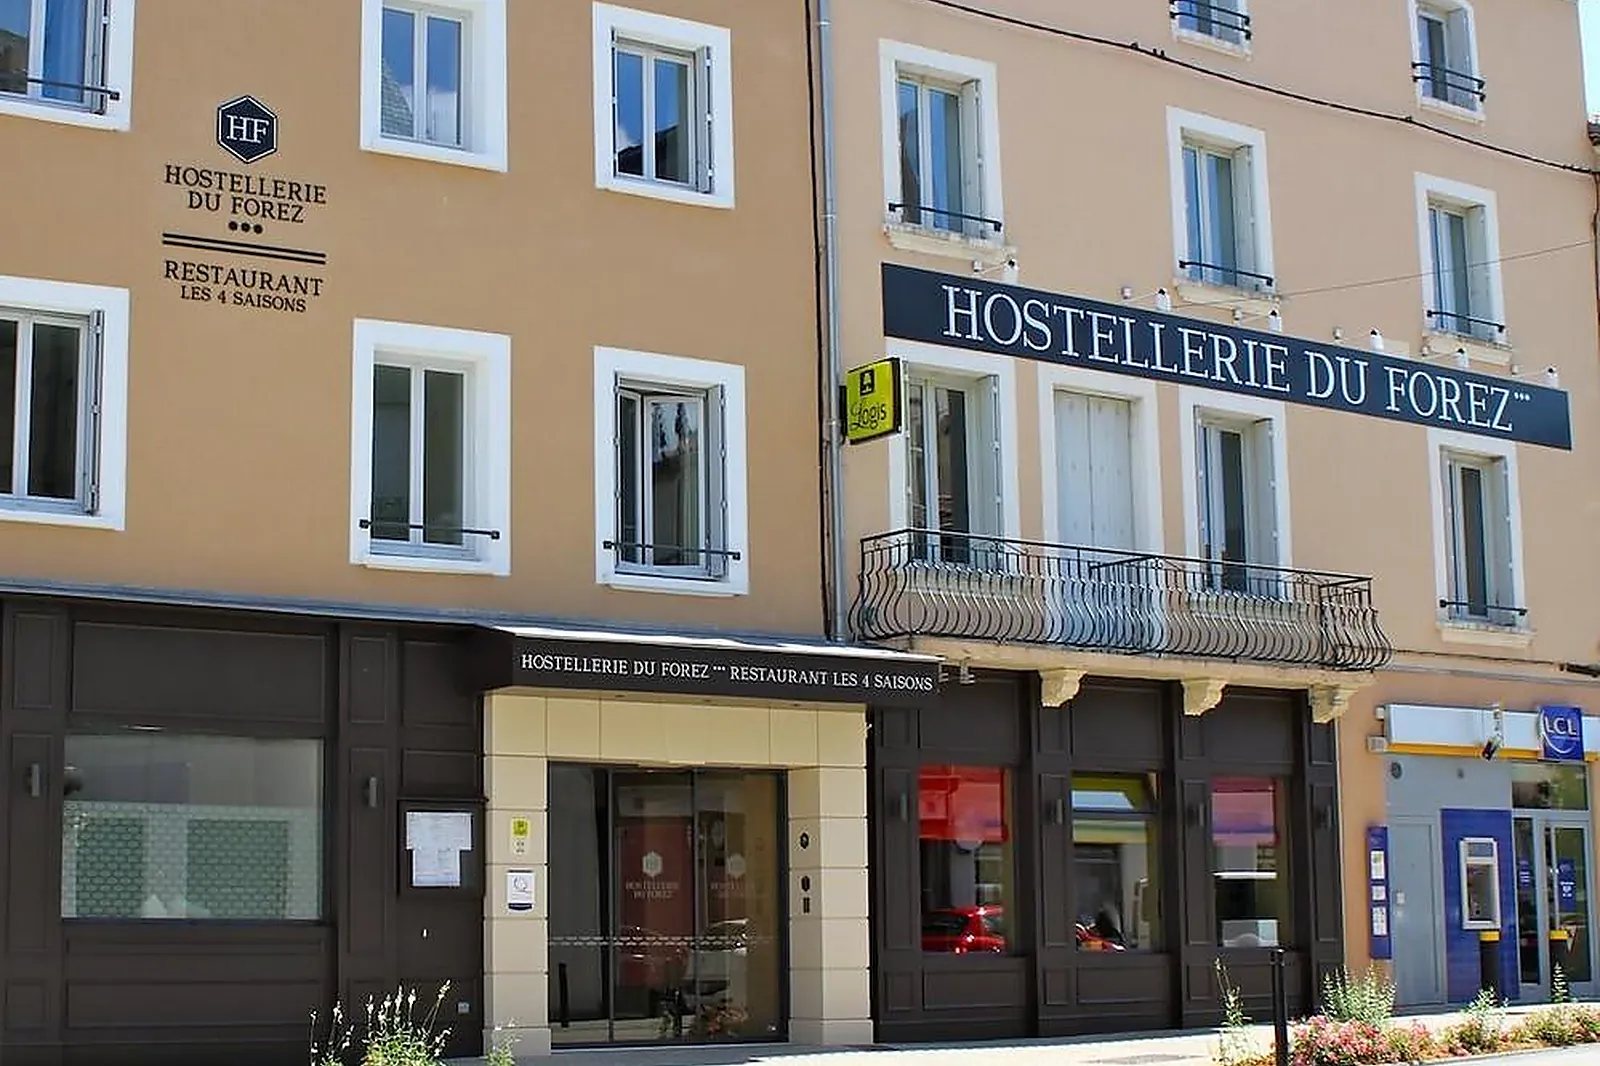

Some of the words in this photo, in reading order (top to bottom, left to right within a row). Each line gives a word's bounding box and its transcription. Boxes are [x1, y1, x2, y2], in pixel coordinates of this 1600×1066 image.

[226, 114, 270, 144] HF
[164, 164, 327, 204] HOSTELLERIE
[188, 190, 221, 211] DU
[231, 197, 304, 223] FOREZ
[164, 260, 324, 296] RESTAURANT
[181, 285, 211, 301] LES
[217, 290, 226, 304] 4
[233, 291, 306, 313] SAISONS
[941, 284, 1290, 392] HOSTELLERIE
[1304, 350, 1369, 405] DU
[849, 402, 887, 430] Logis
[521, 654, 629, 675] HOSTELLERIE
[633, 660, 655, 675] DU
[730, 666, 828, 686] RESTAURANT
[832, 671, 858, 687] LES
[862, 674, 870, 688] 4
[874, 674, 933, 691] SAISONS
[1545, 716, 1577, 735] LCL
